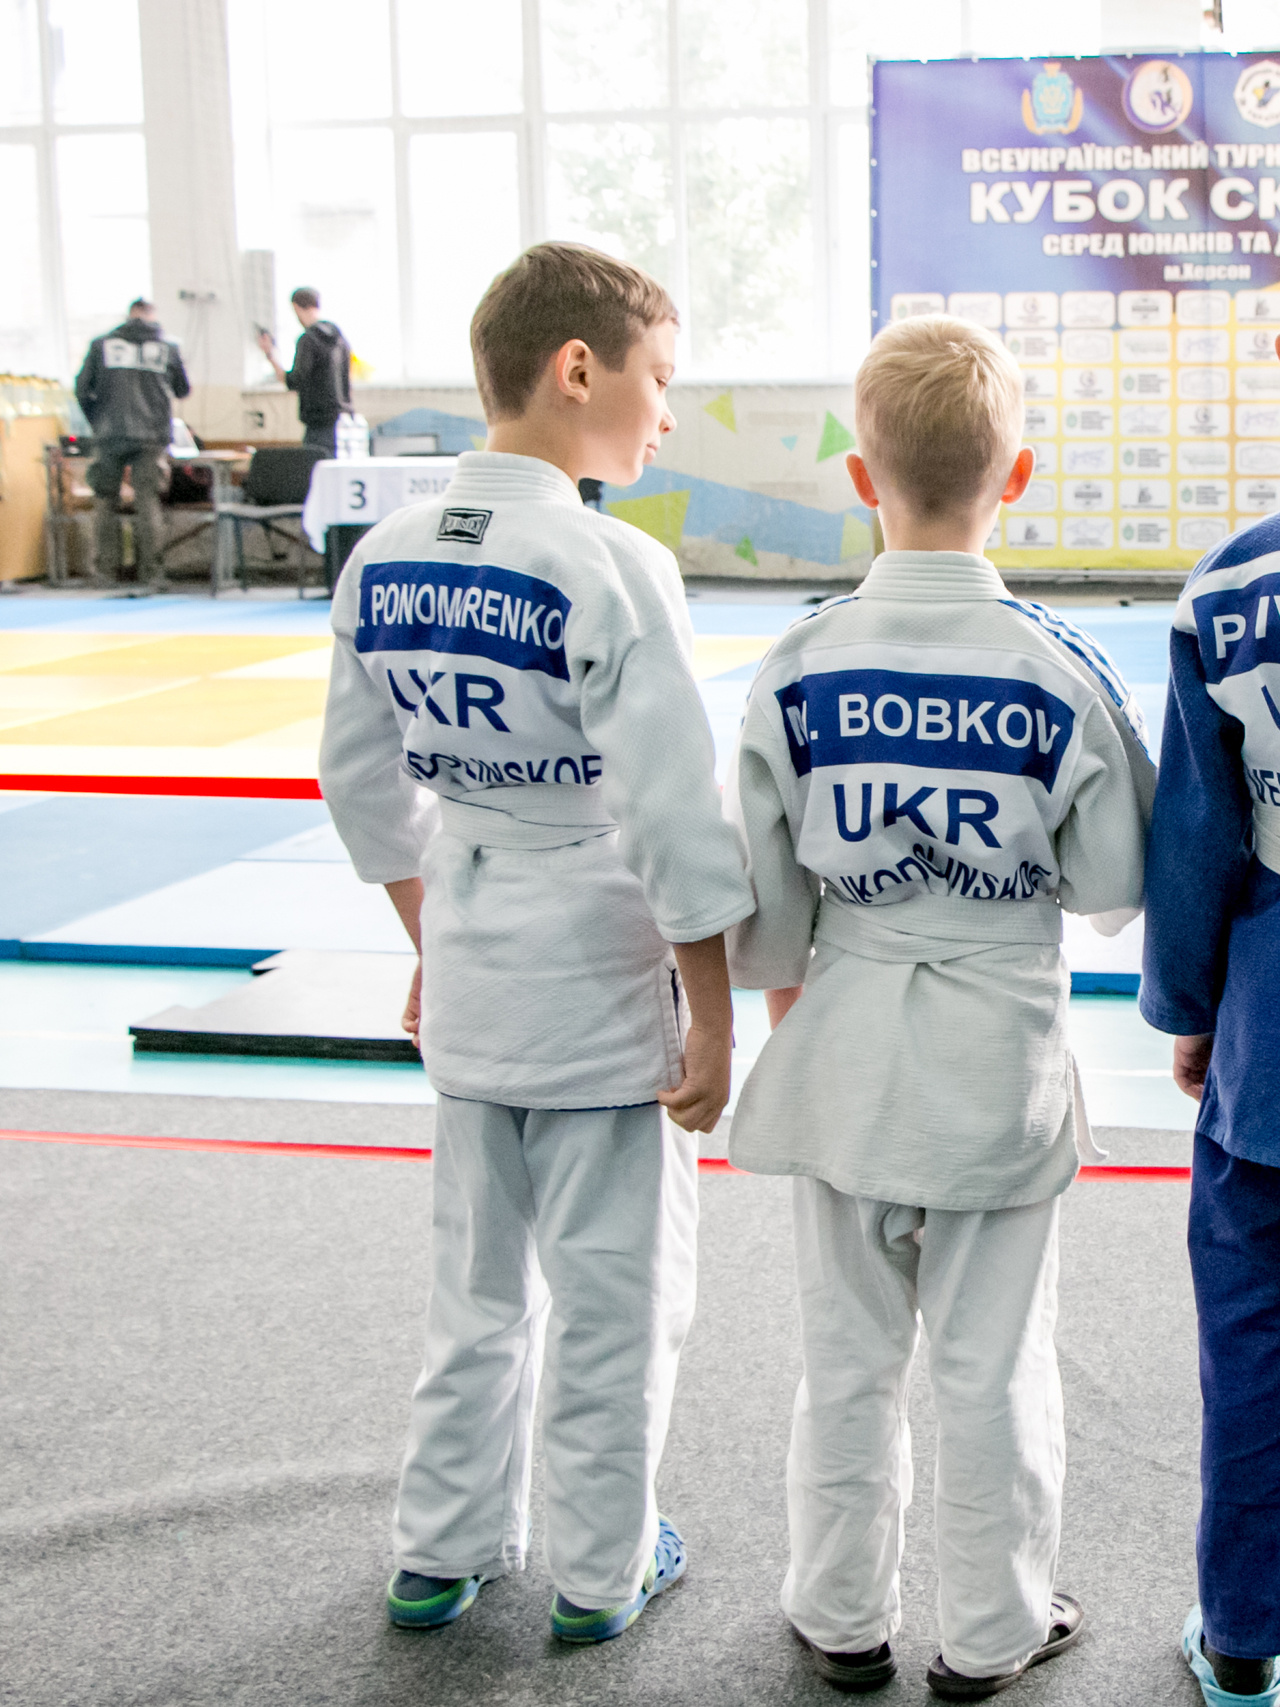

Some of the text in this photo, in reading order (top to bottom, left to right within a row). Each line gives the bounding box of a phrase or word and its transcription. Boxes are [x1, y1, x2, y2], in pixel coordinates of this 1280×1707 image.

[962, 141, 1209, 173] ВСЕУКРАЇНСЬКИЙ
[970, 178, 1190, 223] КУБОК
[1043, 233, 1125, 258] СЕРЕД
[1128, 231, 1234, 256] ЮНАКІВ
[1237, 231, 1271, 254] ТА
[348, 480, 366, 509] 3
[838, 693, 1061, 755] BOBKOV
[833, 783, 1002, 849] UKR
